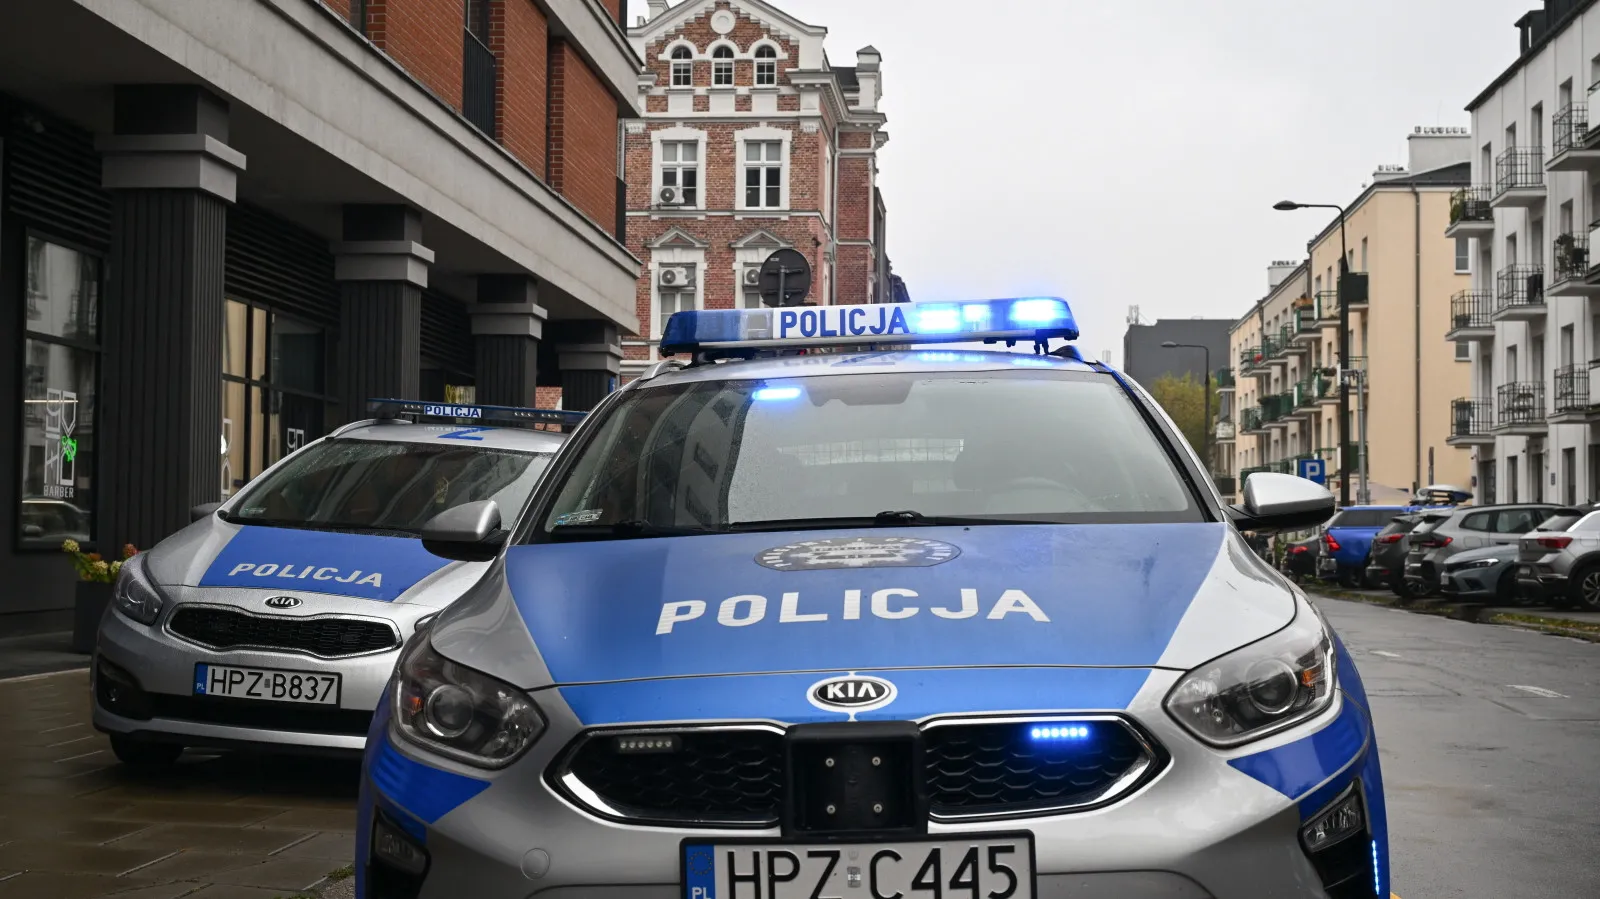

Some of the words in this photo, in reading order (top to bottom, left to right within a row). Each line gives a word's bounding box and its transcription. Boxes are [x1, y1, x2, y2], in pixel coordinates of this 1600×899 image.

[782, 306, 909, 338] POLICJA
[424, 405, 481, 418] POLICJA
[1306, 462, 1320, 480] P
[43, 485, 74, 498] BARBER
[228, 563, 382, 588] POLICJA
[270, 597, 295, 606] KIA
[655, 588, 1051, 635] POLICJA
[210, 668, 263, 697] HPZ
[272, 673, 335, 702] B837
[827, 681, 877, 699] KIA
[727, 850, 843, 899] HPZ
[869, 845, 1018, 899] C445
[691, 887, 711, 899] PL
